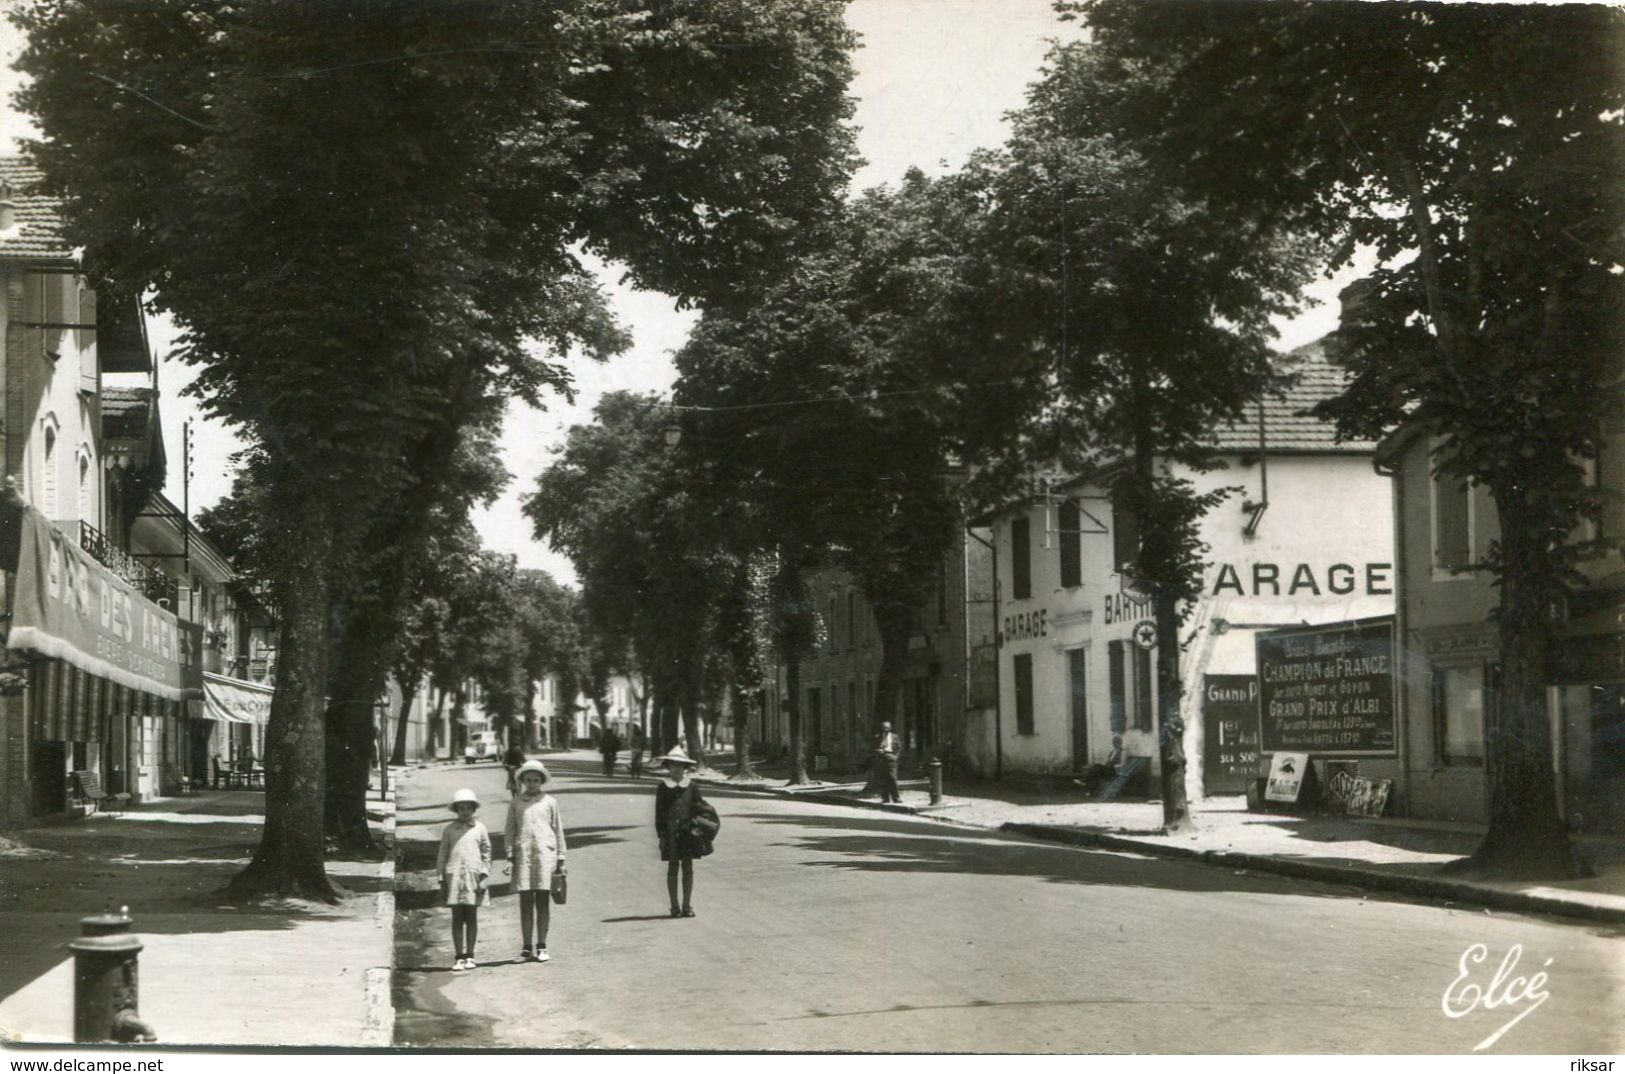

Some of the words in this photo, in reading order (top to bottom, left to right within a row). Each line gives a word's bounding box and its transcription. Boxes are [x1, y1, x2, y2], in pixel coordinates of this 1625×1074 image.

[1199, 562, 1393, 596] ARAGE
[100, 577, 132, 643] DES
[1004, 609, 1047, 641] GARAGE
[1263, 661, 1321, 682] CHAMPION
[1336, 655, 1388, 678] FRANCE
[1208, 684, 1246, 701] GRAND
[1340, 679, 1371, 694] GOYON
[1269, 700, 1305, 717] GRAND
[1309, 697, 1337, 715] PRIX
[1342, 698, 1380, 714] d'ALBI
